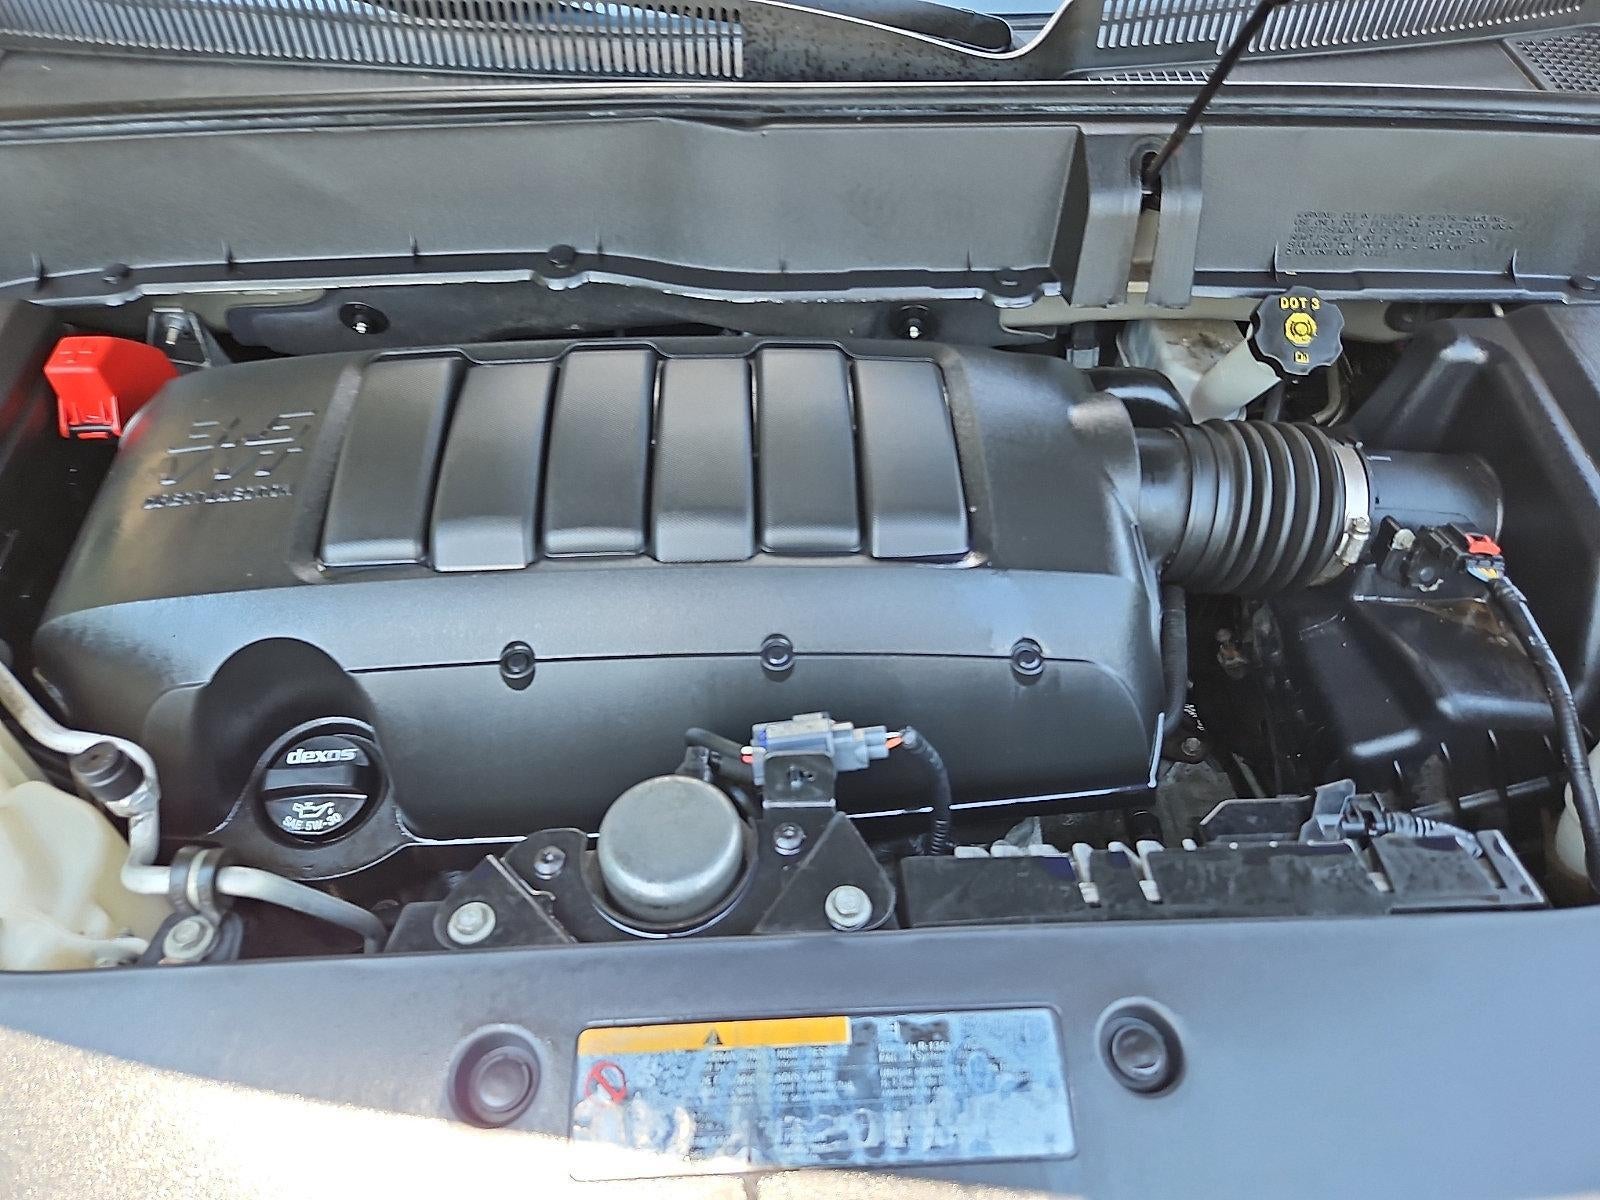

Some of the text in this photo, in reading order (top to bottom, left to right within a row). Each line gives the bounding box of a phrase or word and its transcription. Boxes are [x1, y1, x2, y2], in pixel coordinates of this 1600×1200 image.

[1280, 296, 1320, 311] DOT 3
[286, 748, 360, 765] dexos
[283, 812, 342, 831] SAE 5W-30
